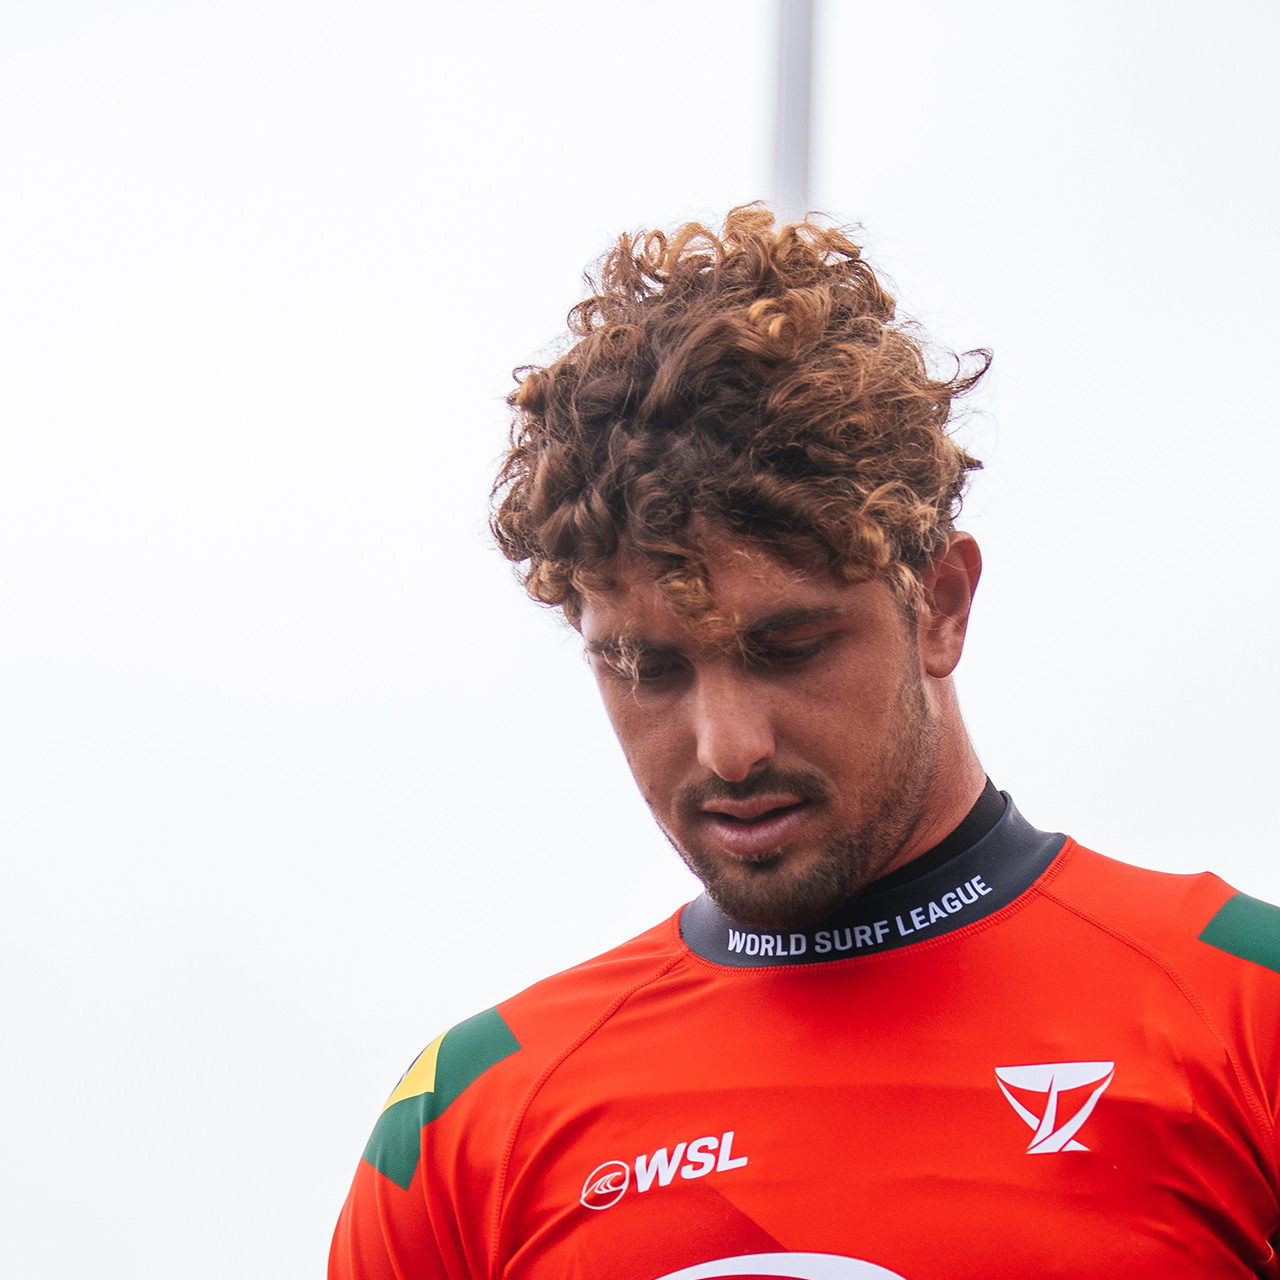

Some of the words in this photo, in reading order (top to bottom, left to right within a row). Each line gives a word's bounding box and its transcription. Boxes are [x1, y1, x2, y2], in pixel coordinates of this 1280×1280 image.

[727, 929, 806, 957] WORLD
[814, 920, 891, 953] SURF
[895, 874, 993, 936] LEAGUE
[634, 1131, 748, 1193] WSL
